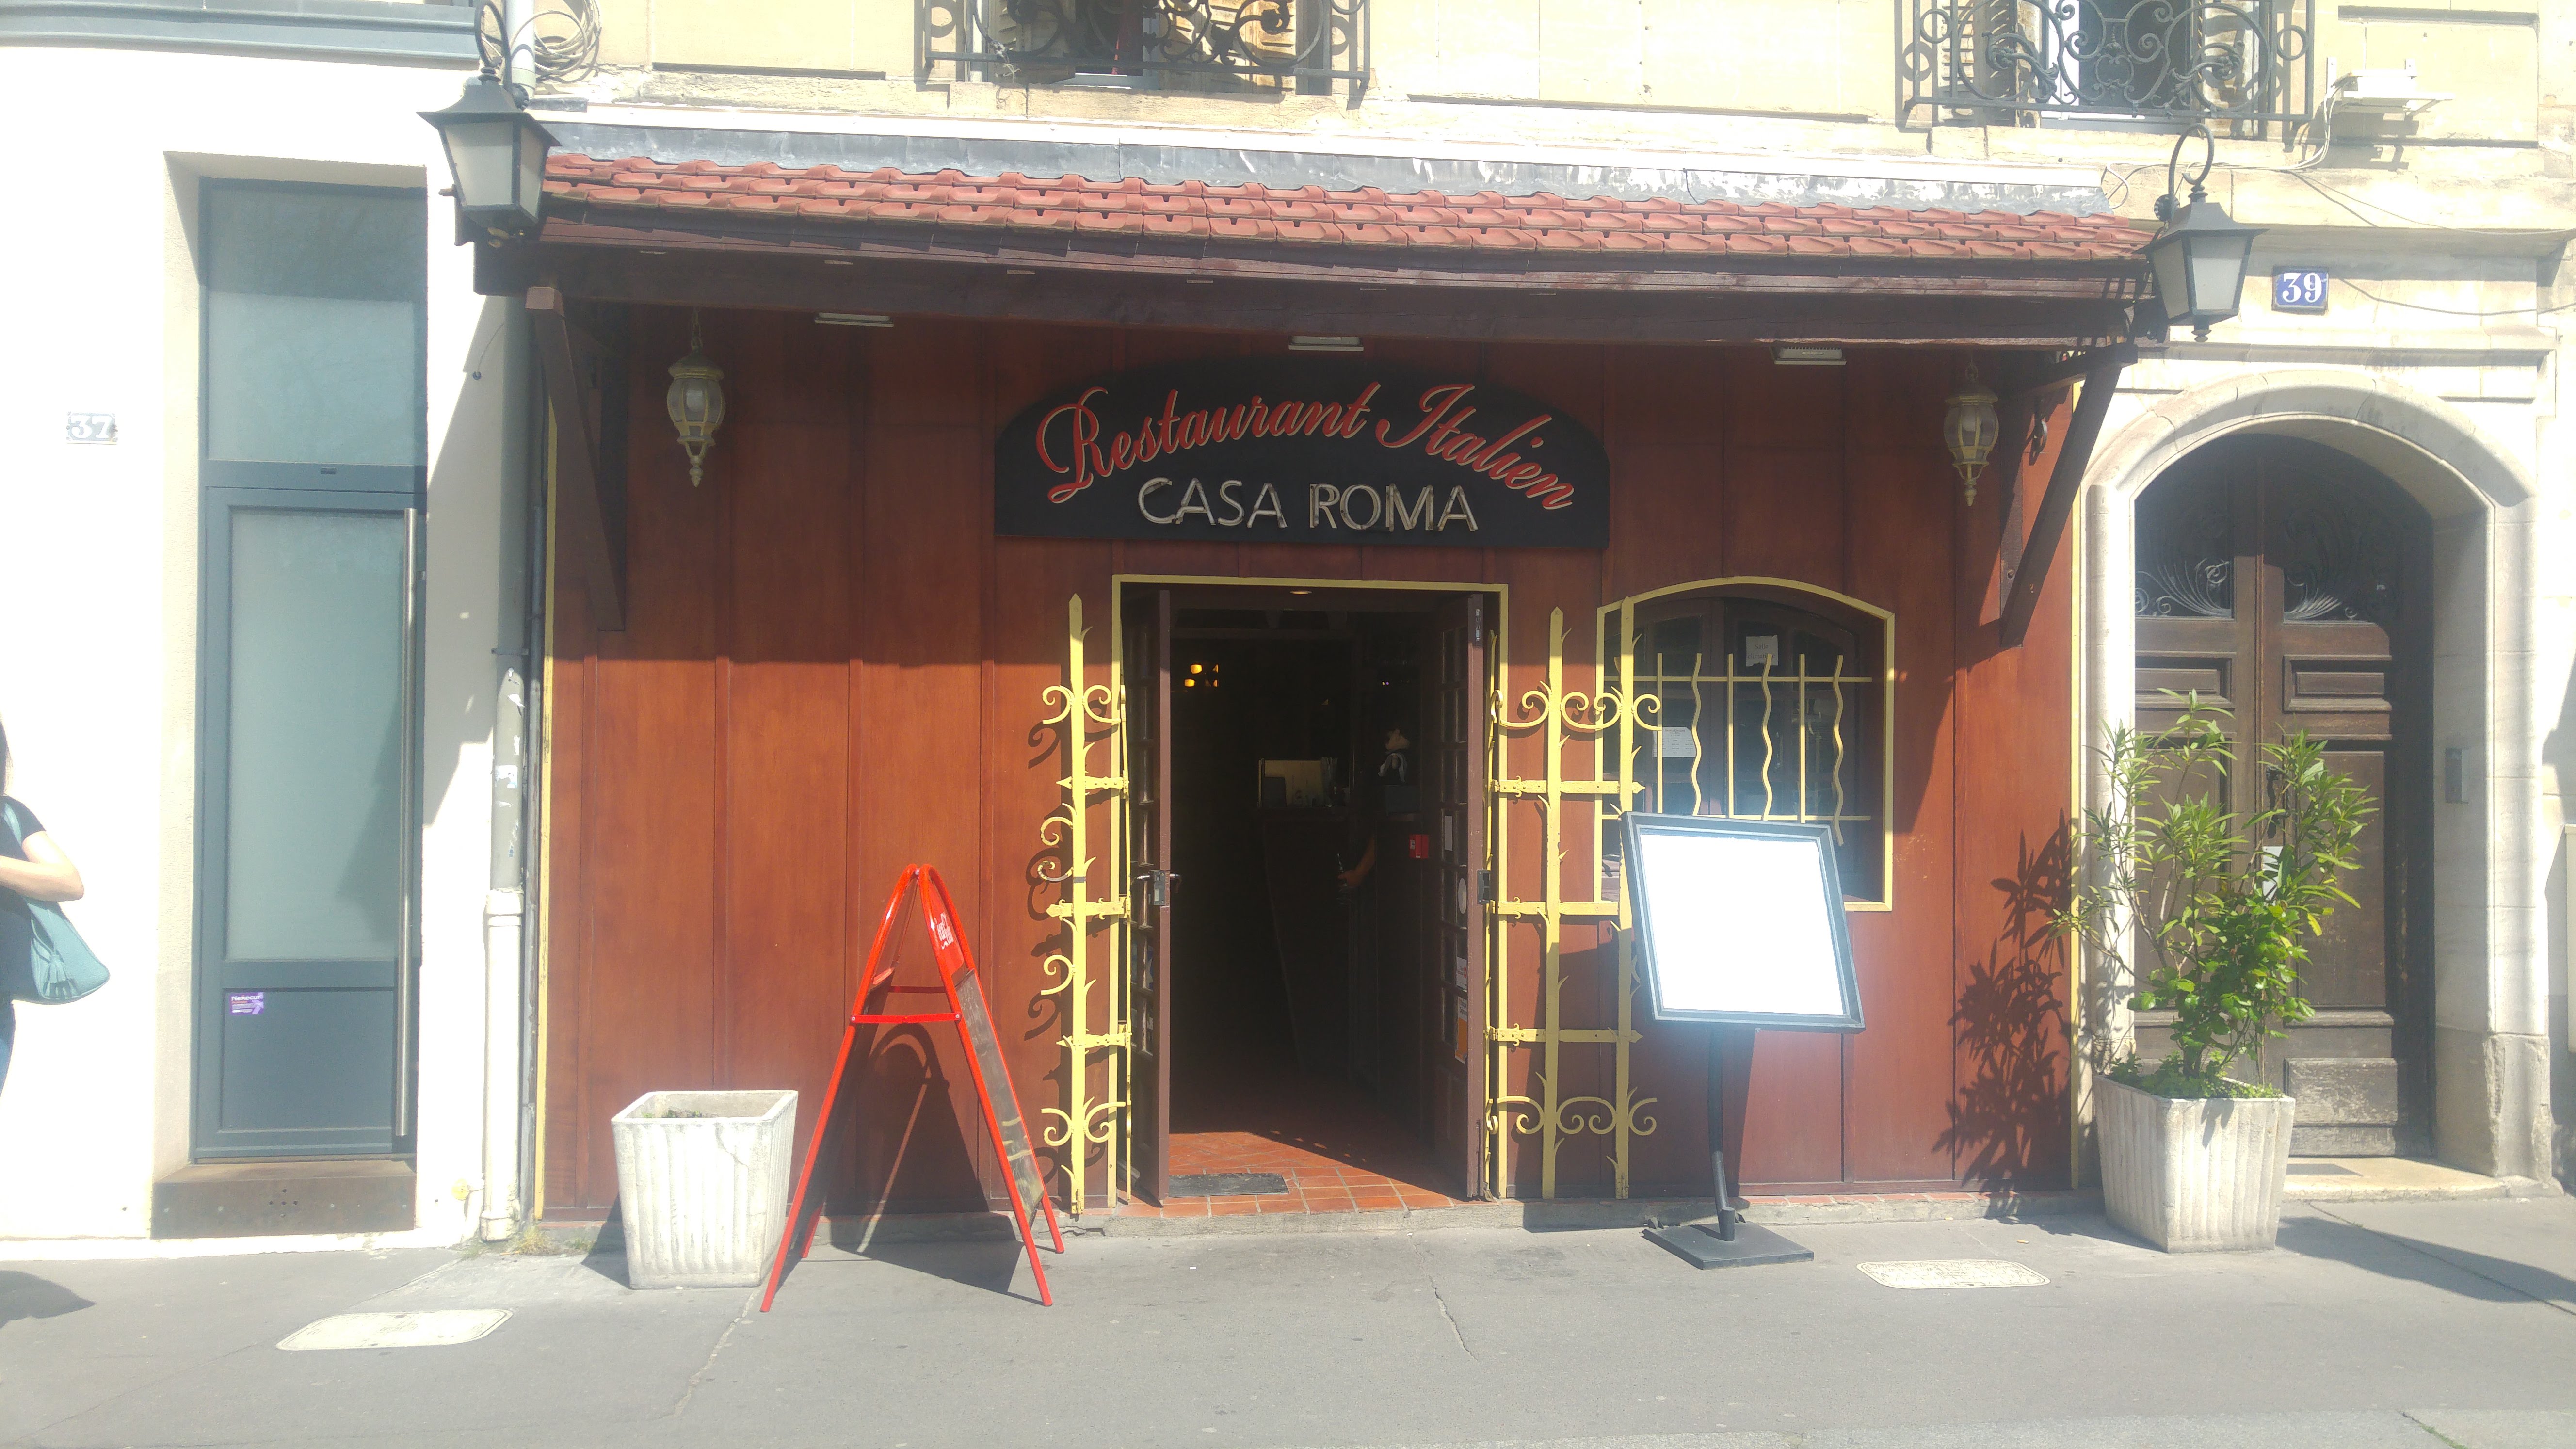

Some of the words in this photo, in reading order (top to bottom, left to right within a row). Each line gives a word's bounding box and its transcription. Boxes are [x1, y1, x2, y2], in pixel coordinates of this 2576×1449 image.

[2282, 272, 2322, 303] 39
[71, 415, 113, 439] 37
[1036, 381, 1381, 504] Restaurant
[1375, 383, 1574, 510] Italien
[1137, 477, 1288, 529] CASA
[1309, 483, 1478, 531] ROMA
